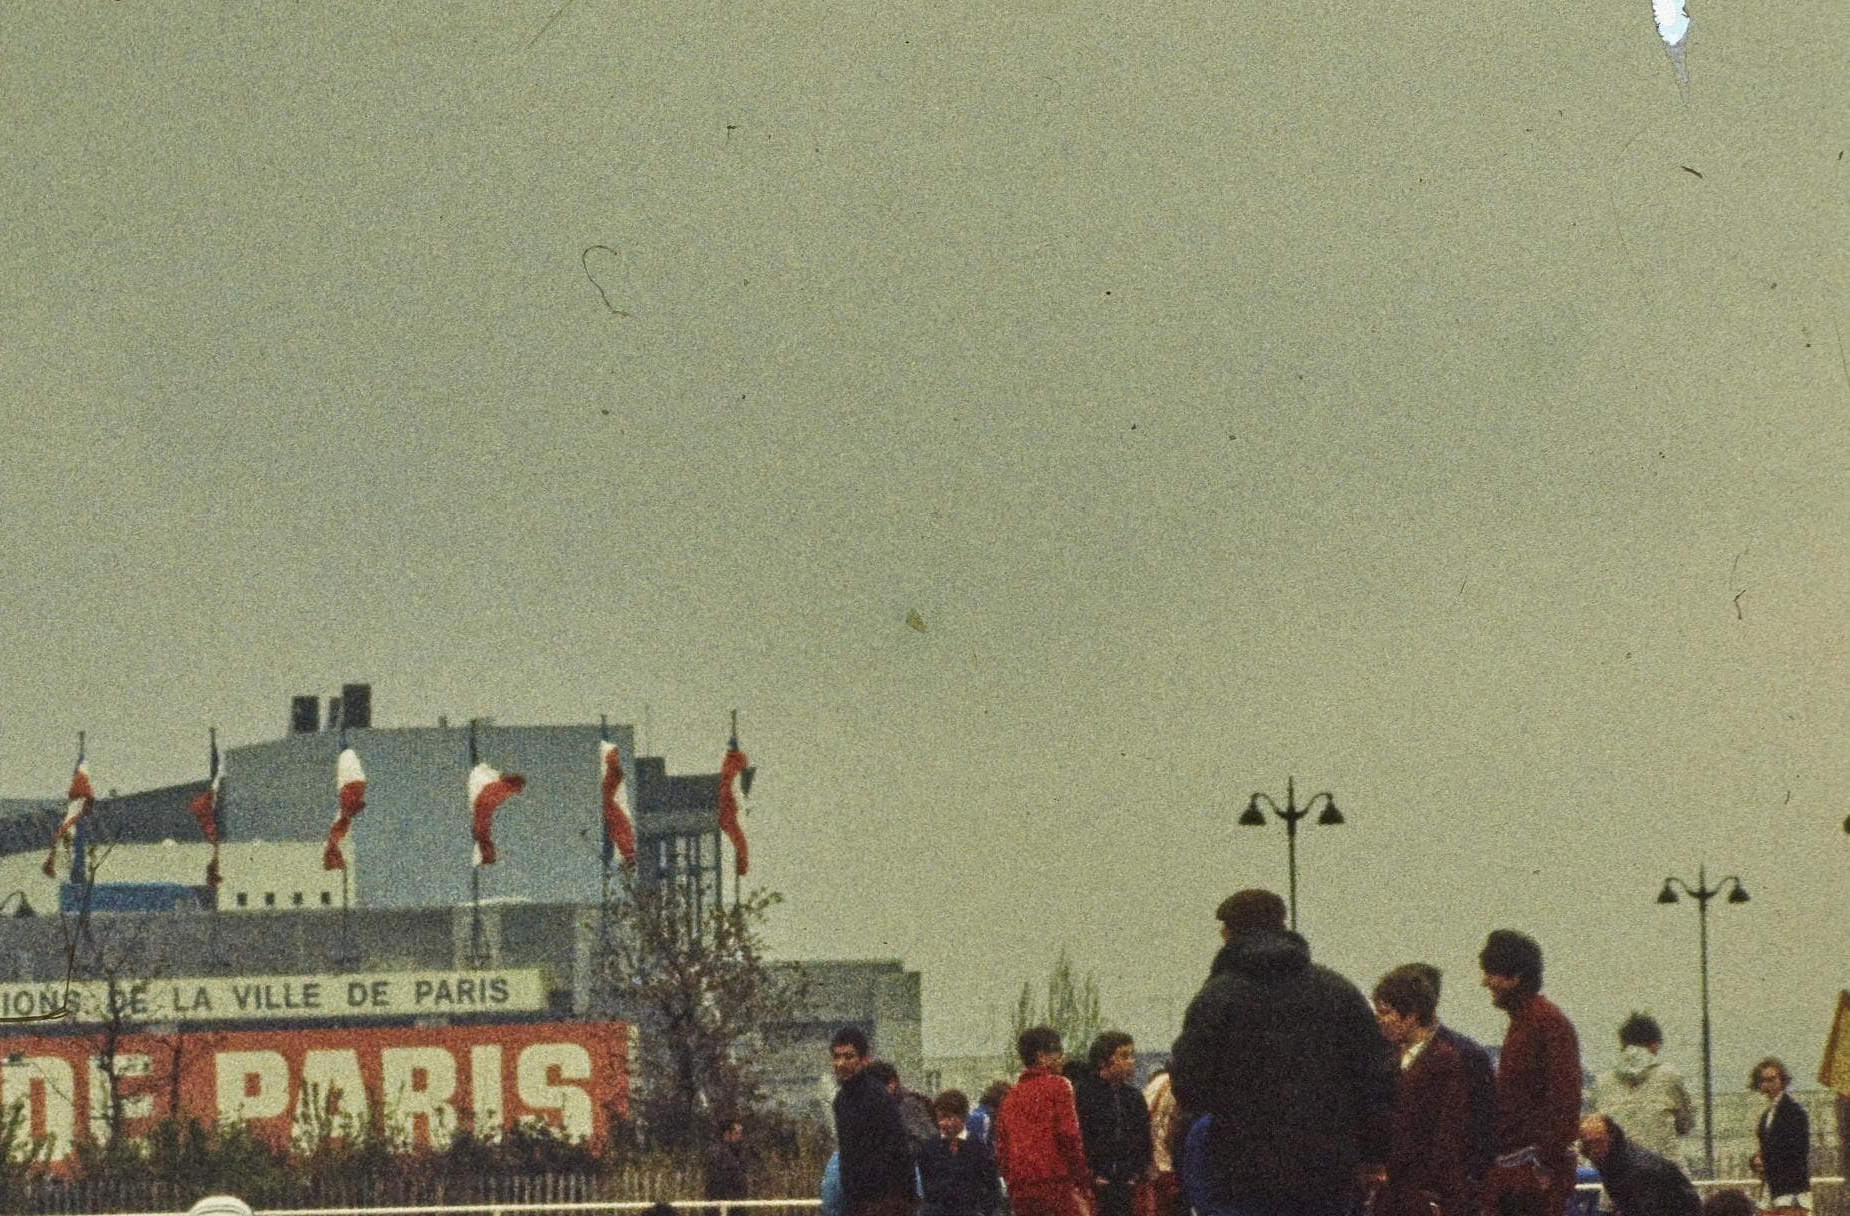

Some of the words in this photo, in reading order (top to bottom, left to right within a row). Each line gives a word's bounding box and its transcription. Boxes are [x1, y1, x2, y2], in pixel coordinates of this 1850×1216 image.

[173, 986, 213, 1013] LA
[232, 983, 321, 1010] VILLE
[348, 980, 390, 1008] DE
[414, 977, 509, 1005] PARIS
[214, 1043, 595, 1157] PARIS
